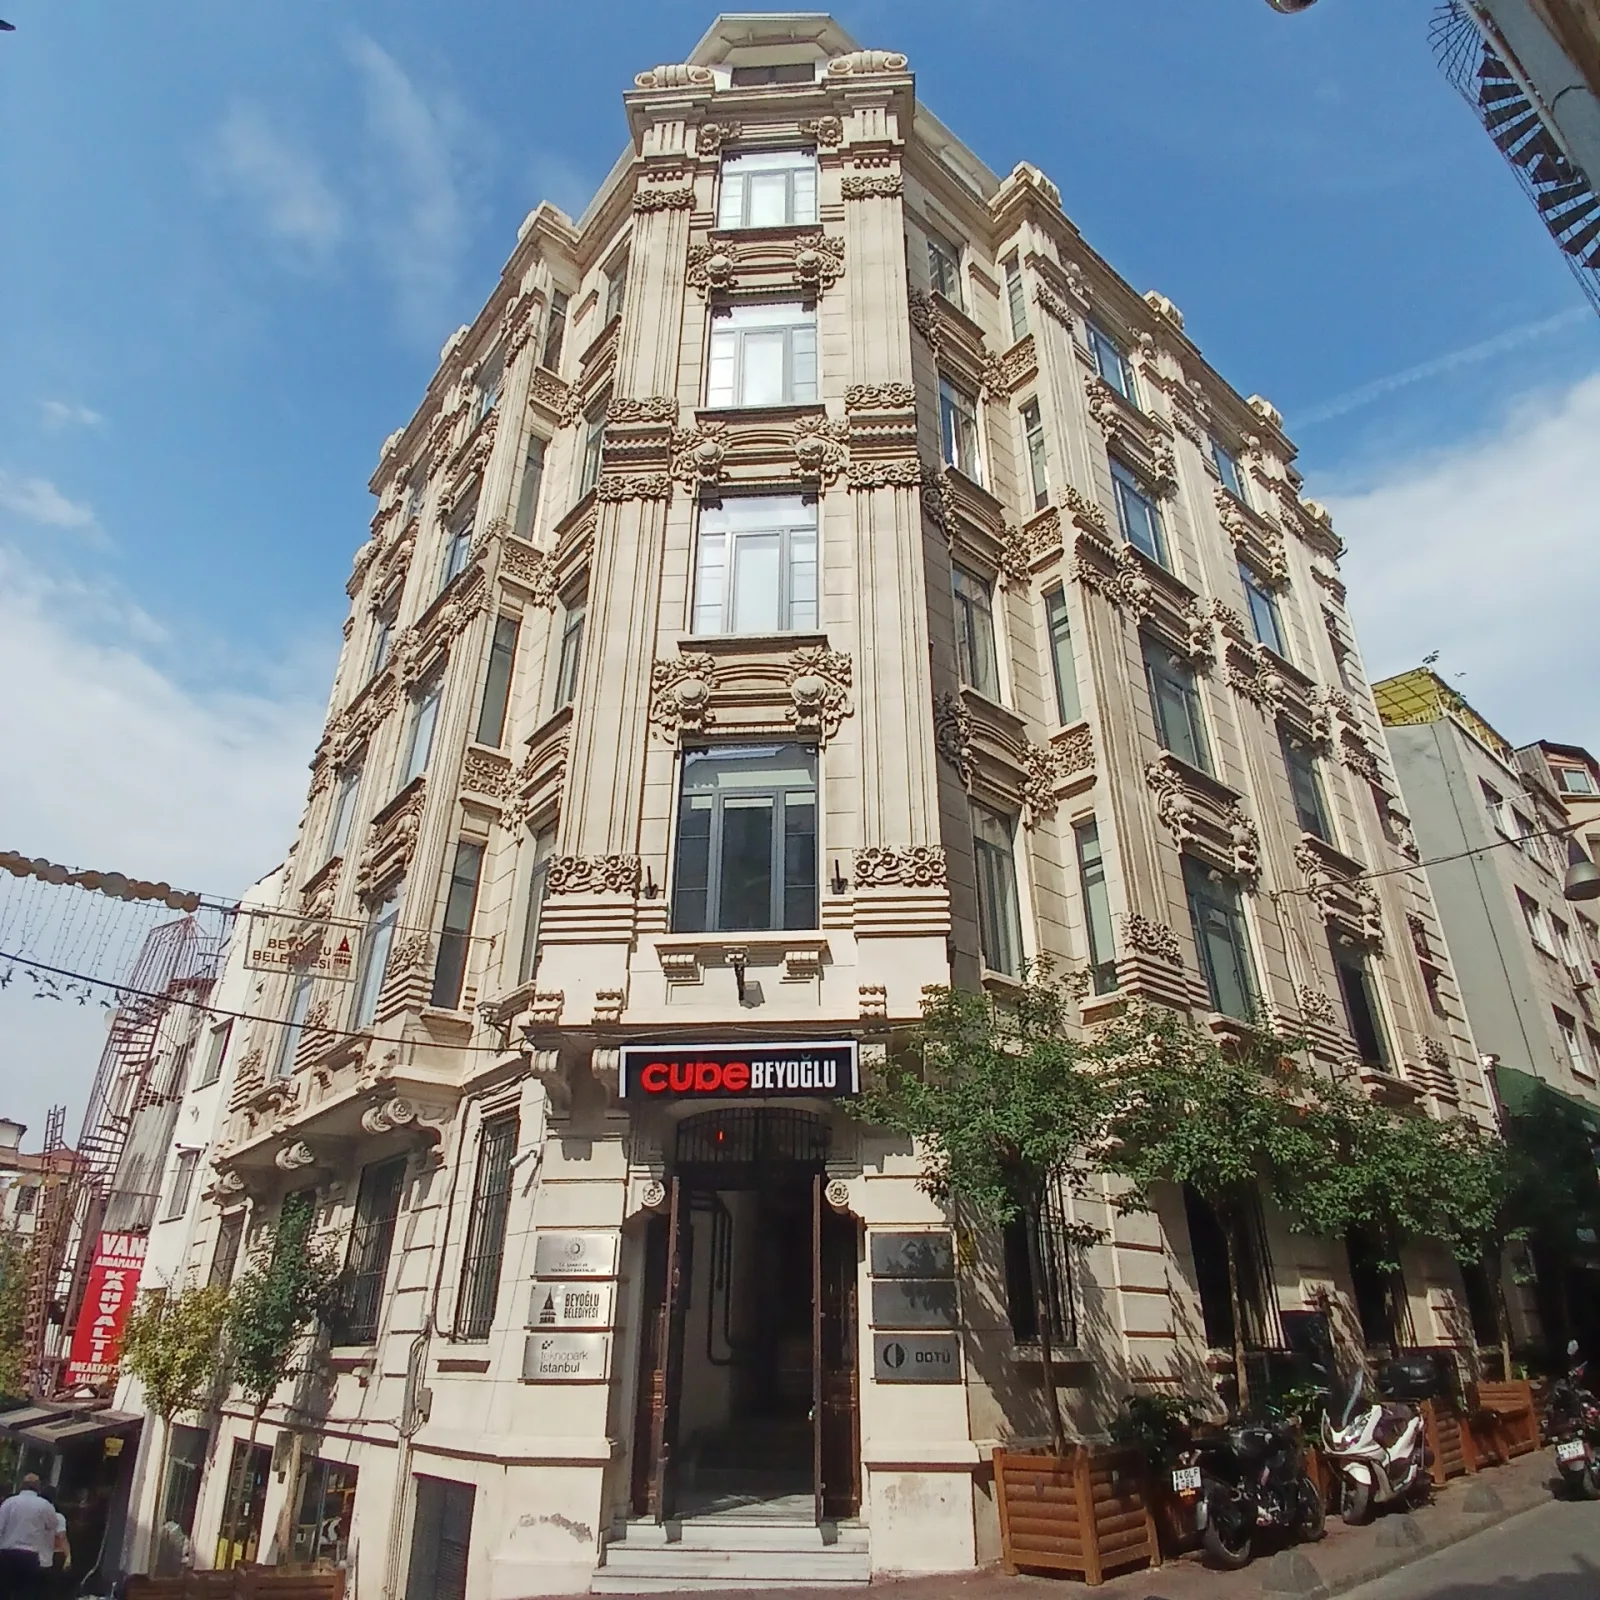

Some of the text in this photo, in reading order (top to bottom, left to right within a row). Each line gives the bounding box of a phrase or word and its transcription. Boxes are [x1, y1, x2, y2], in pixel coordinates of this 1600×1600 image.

[252, 950, 331, 970] BELEDESİ
[751, 1053, 837, 1089] BEYOĞLU
[102, 1233, 147, 1258] VAN
[565, 1290, 600, 1307] BEYOĞLU
[90, 1270, 127, 1362] KAHVALTI
[564, 1307, 599, 1319] BELEDİYESİ
[541, 1350, 588, 1361] teknopark
[540, 1361, 580, 1373] istanbul
